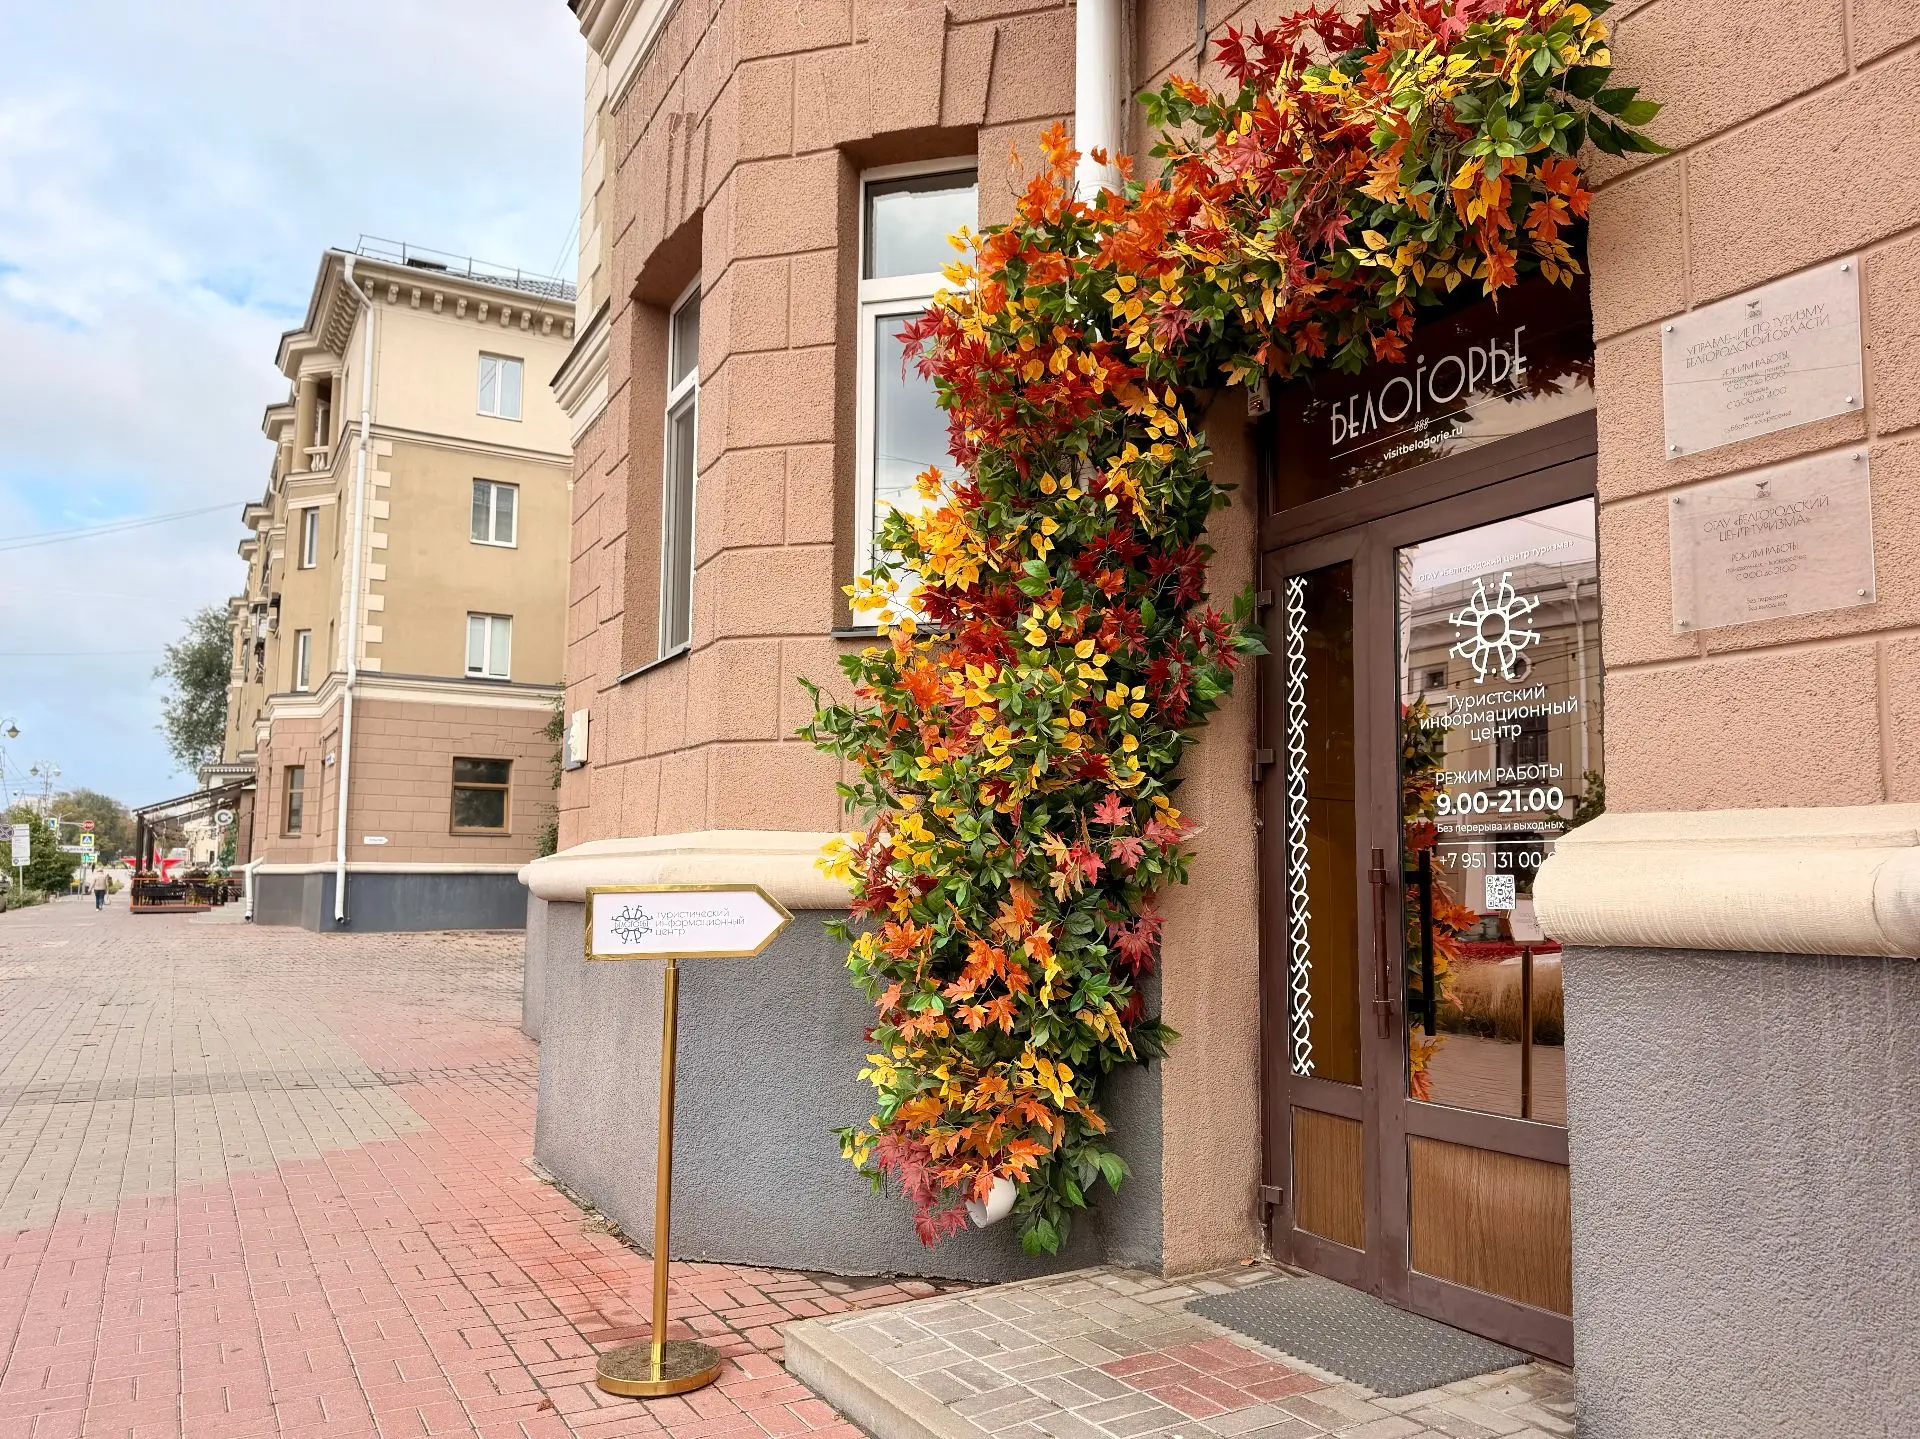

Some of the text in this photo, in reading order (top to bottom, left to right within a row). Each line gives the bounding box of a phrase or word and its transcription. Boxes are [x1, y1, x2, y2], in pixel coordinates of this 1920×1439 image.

[1686, 303, 1825, 357] УПРАВЛЕНИЕ ПО ТУРИЗМУ
[1686, 314, 1830, 368] БЕЛГОРОДСКОЙ ОБЛАСТИ
[1330, 325, 1528, 445] БЕЛОГОРЬЕ
[1383, 425, 1463, 461] visitbelogorie.ru
[1703, 494, 1829, 533] ОГАУ «БЕЛГОРОДСКИЙ
[1720, 526, 1750, 542] ЦЕНТР
[1766, 542, 1799, 555] РАБОТЫ
[1418, 571, 1440, 582] ОГАУ
[1504, 550, 1531, 564] центр
[1447, 682, 1545, 713] Туристский
[1420, 696, 1579, 731] информационный
[1471, 724, 1522, 742] центр
[1435, 763, 1563, 786] РЕЖИМ РАБОТЫ
[1436, 786, 1564, 816] 9.00-21.00
[1437, 824, 1453, 833] Без
[1455, 823, 1502, 835] перерыва
[1513, 820, 1565, 831] выходных
[1439, 853, 1458, 868] +7
[1462, 853, 1487, 868] 951
[1490, 852, 1513, 868] 131
[1518, 851, 1542, 868] 00
[655, 915, 745, 929] информационный
[656, 907, 730, 920] туристический
[655, 928, 686, 937] центр
